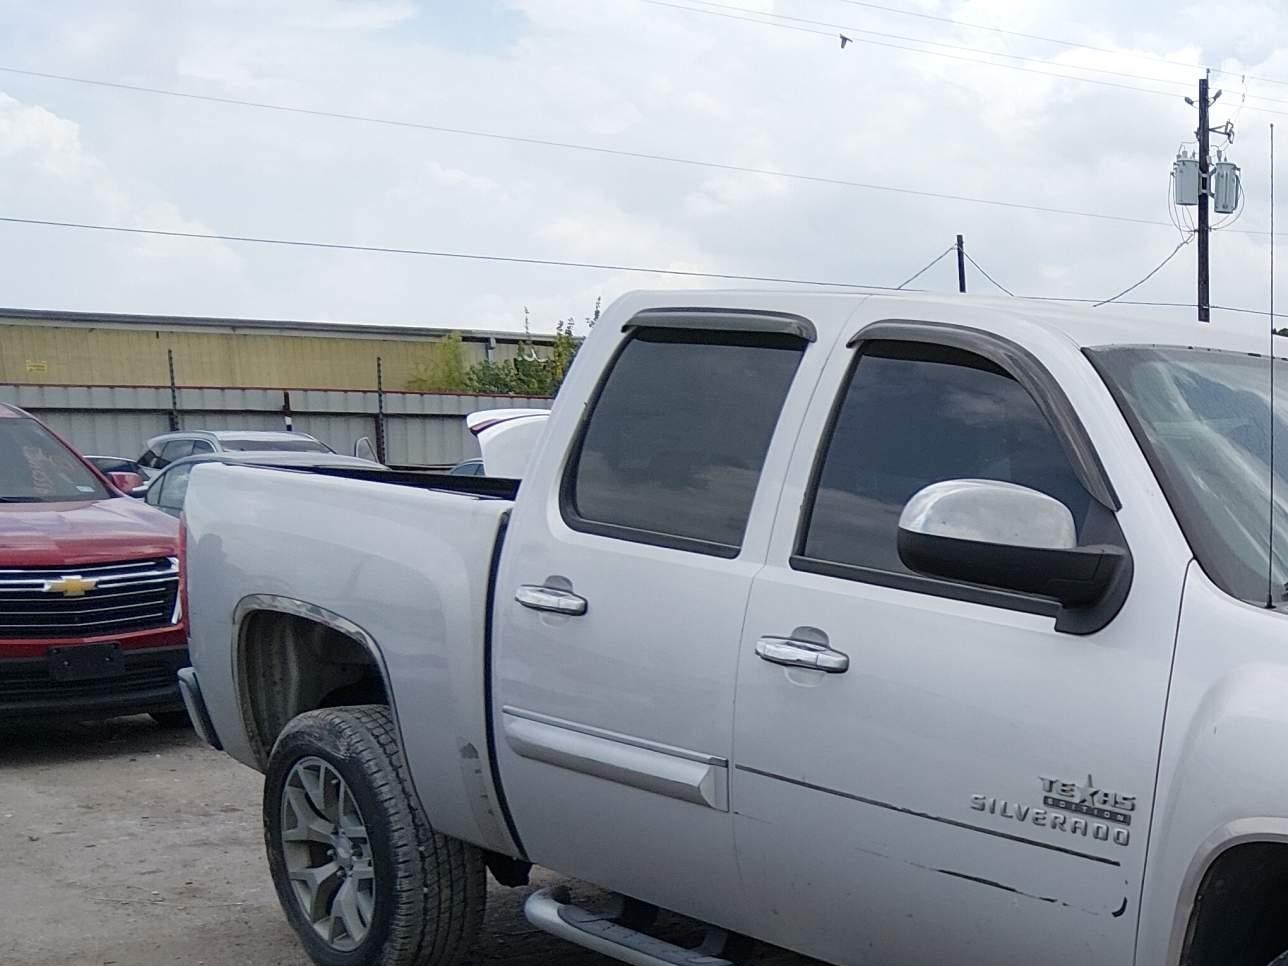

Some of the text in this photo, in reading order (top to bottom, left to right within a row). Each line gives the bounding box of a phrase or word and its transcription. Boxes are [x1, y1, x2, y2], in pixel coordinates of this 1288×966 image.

[1037, 773, 1137, 812] TEXAS
[1045, 797, 1128, 823] EDITION
[969, 793, 1131, 846] SILVERADO
